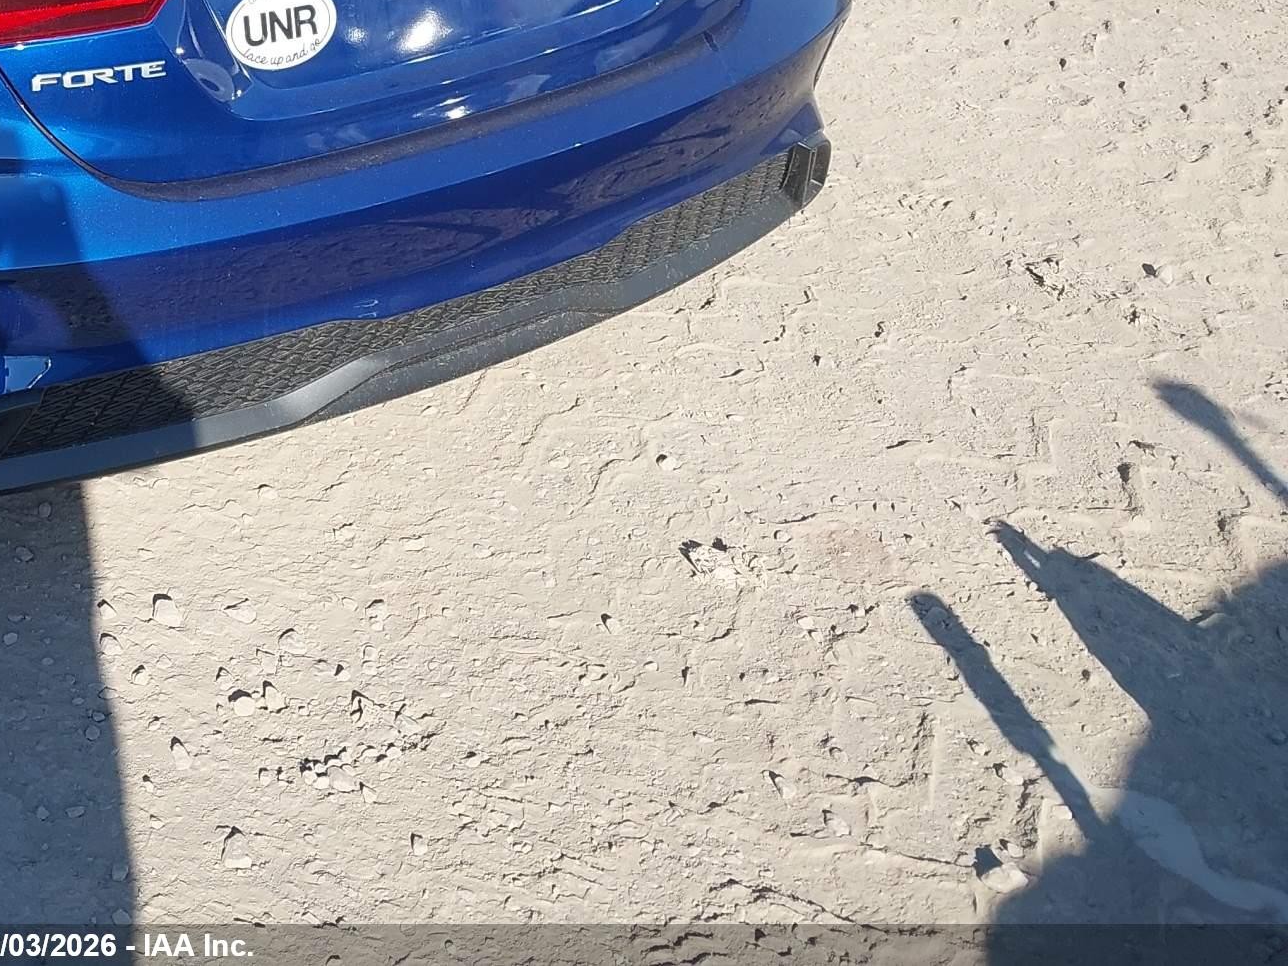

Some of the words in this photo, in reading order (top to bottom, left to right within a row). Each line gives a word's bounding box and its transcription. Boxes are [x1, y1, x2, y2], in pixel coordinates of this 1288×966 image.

[243, 4, 318, 47] UNR
[31, 60, 167, 92] FORTE
[270, 55, 284, 66] up
